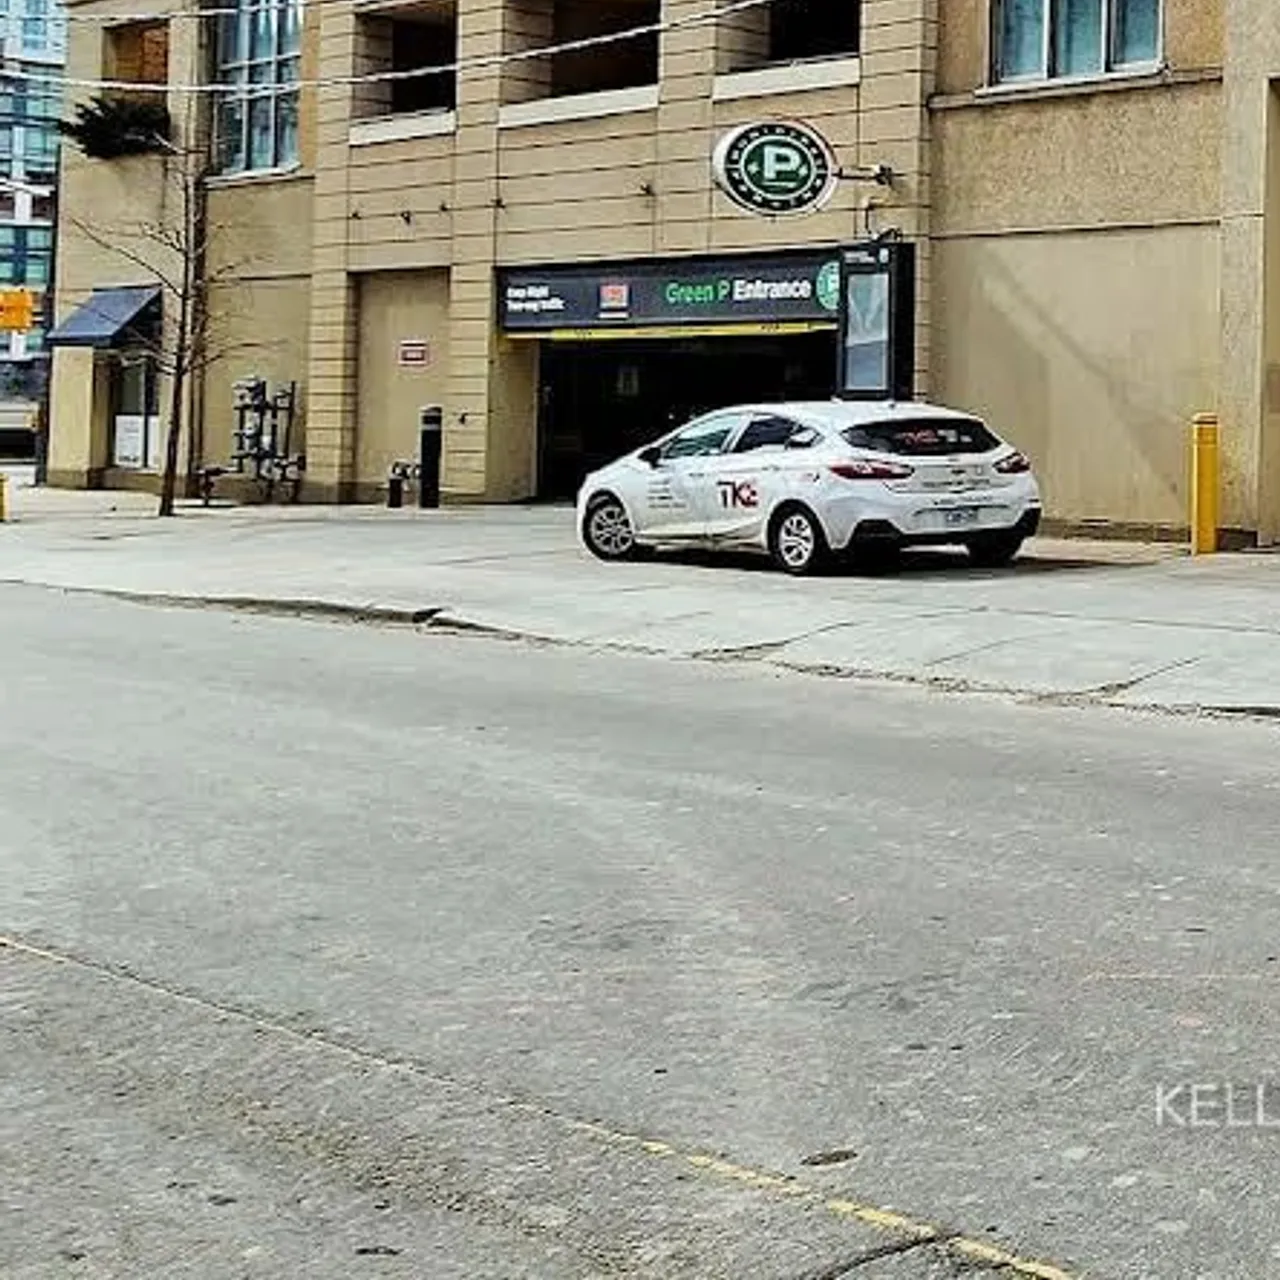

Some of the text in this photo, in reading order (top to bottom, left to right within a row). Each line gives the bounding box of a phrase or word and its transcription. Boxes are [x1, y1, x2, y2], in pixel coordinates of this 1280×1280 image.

[763, 144, 801, 180] P
[665, 282, 714, 304] Green
[717, 280, 731, 301] P
[733, 278, 811, 301] Entrance
